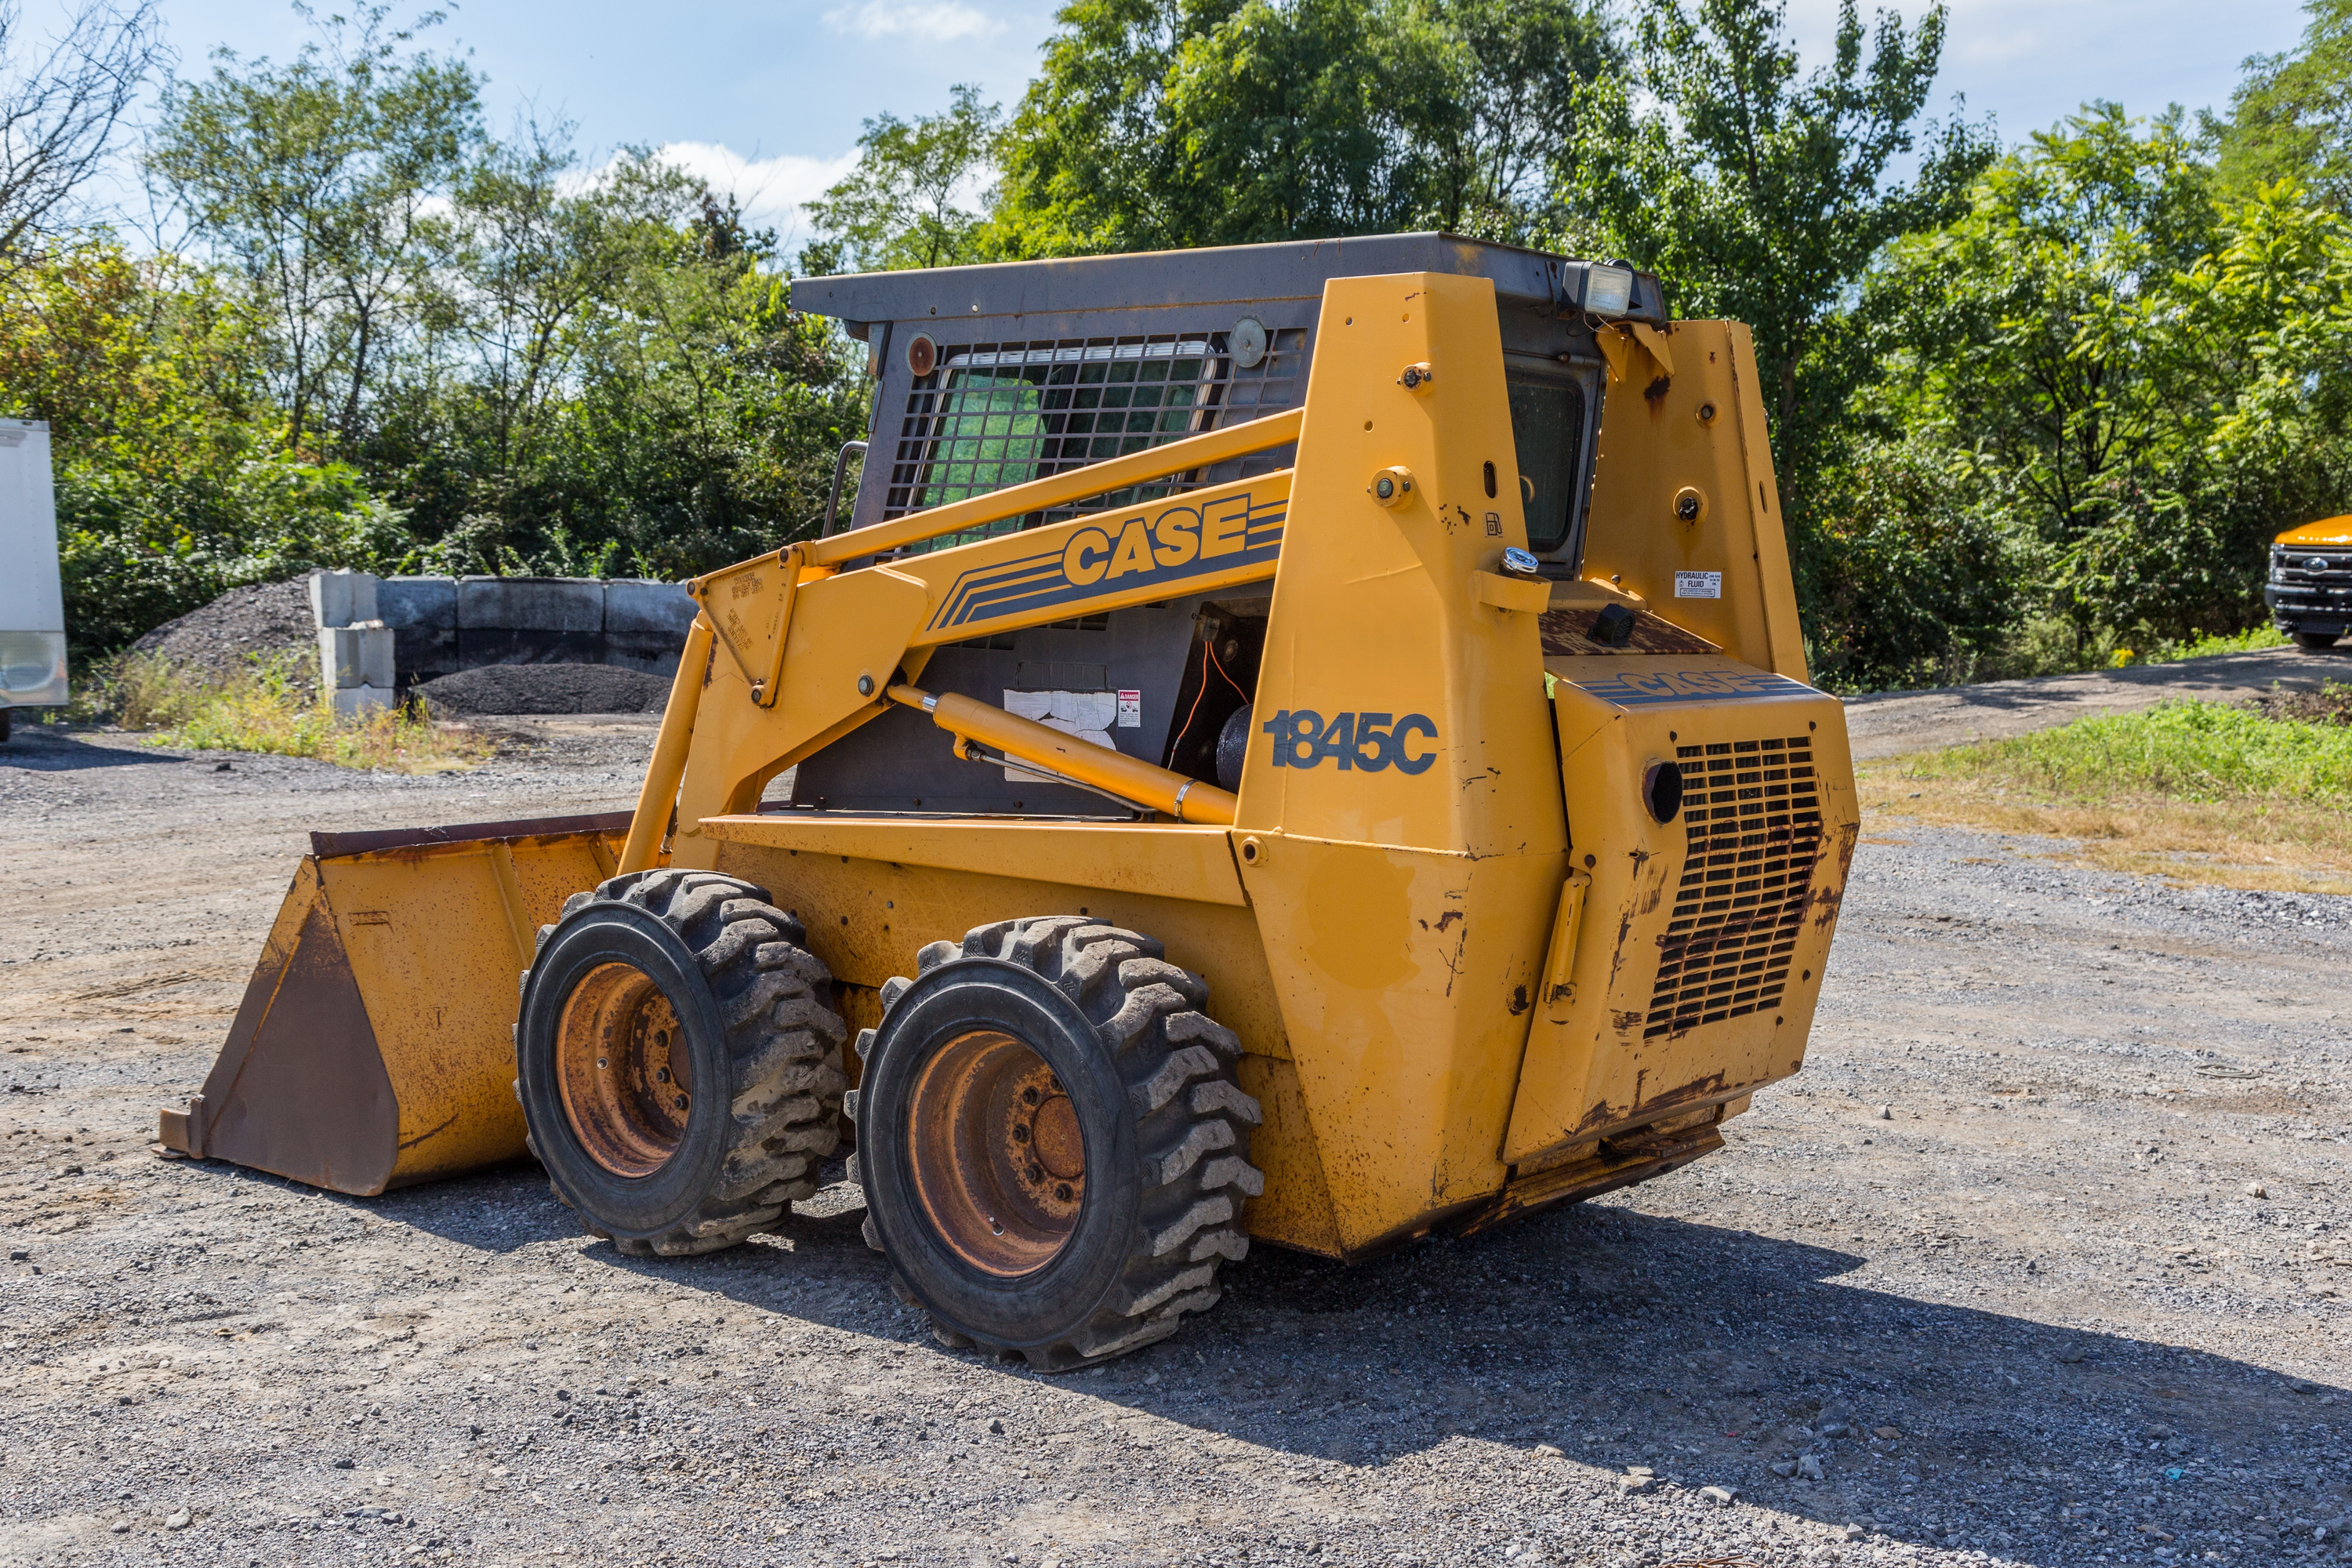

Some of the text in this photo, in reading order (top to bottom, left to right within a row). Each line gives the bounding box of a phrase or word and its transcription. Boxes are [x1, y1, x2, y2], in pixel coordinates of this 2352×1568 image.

[1062, 493, 1250, 586] CASE
[1617, 670, 1766, 697] CASE
[1263, 710, 1438, 775] 1845C
